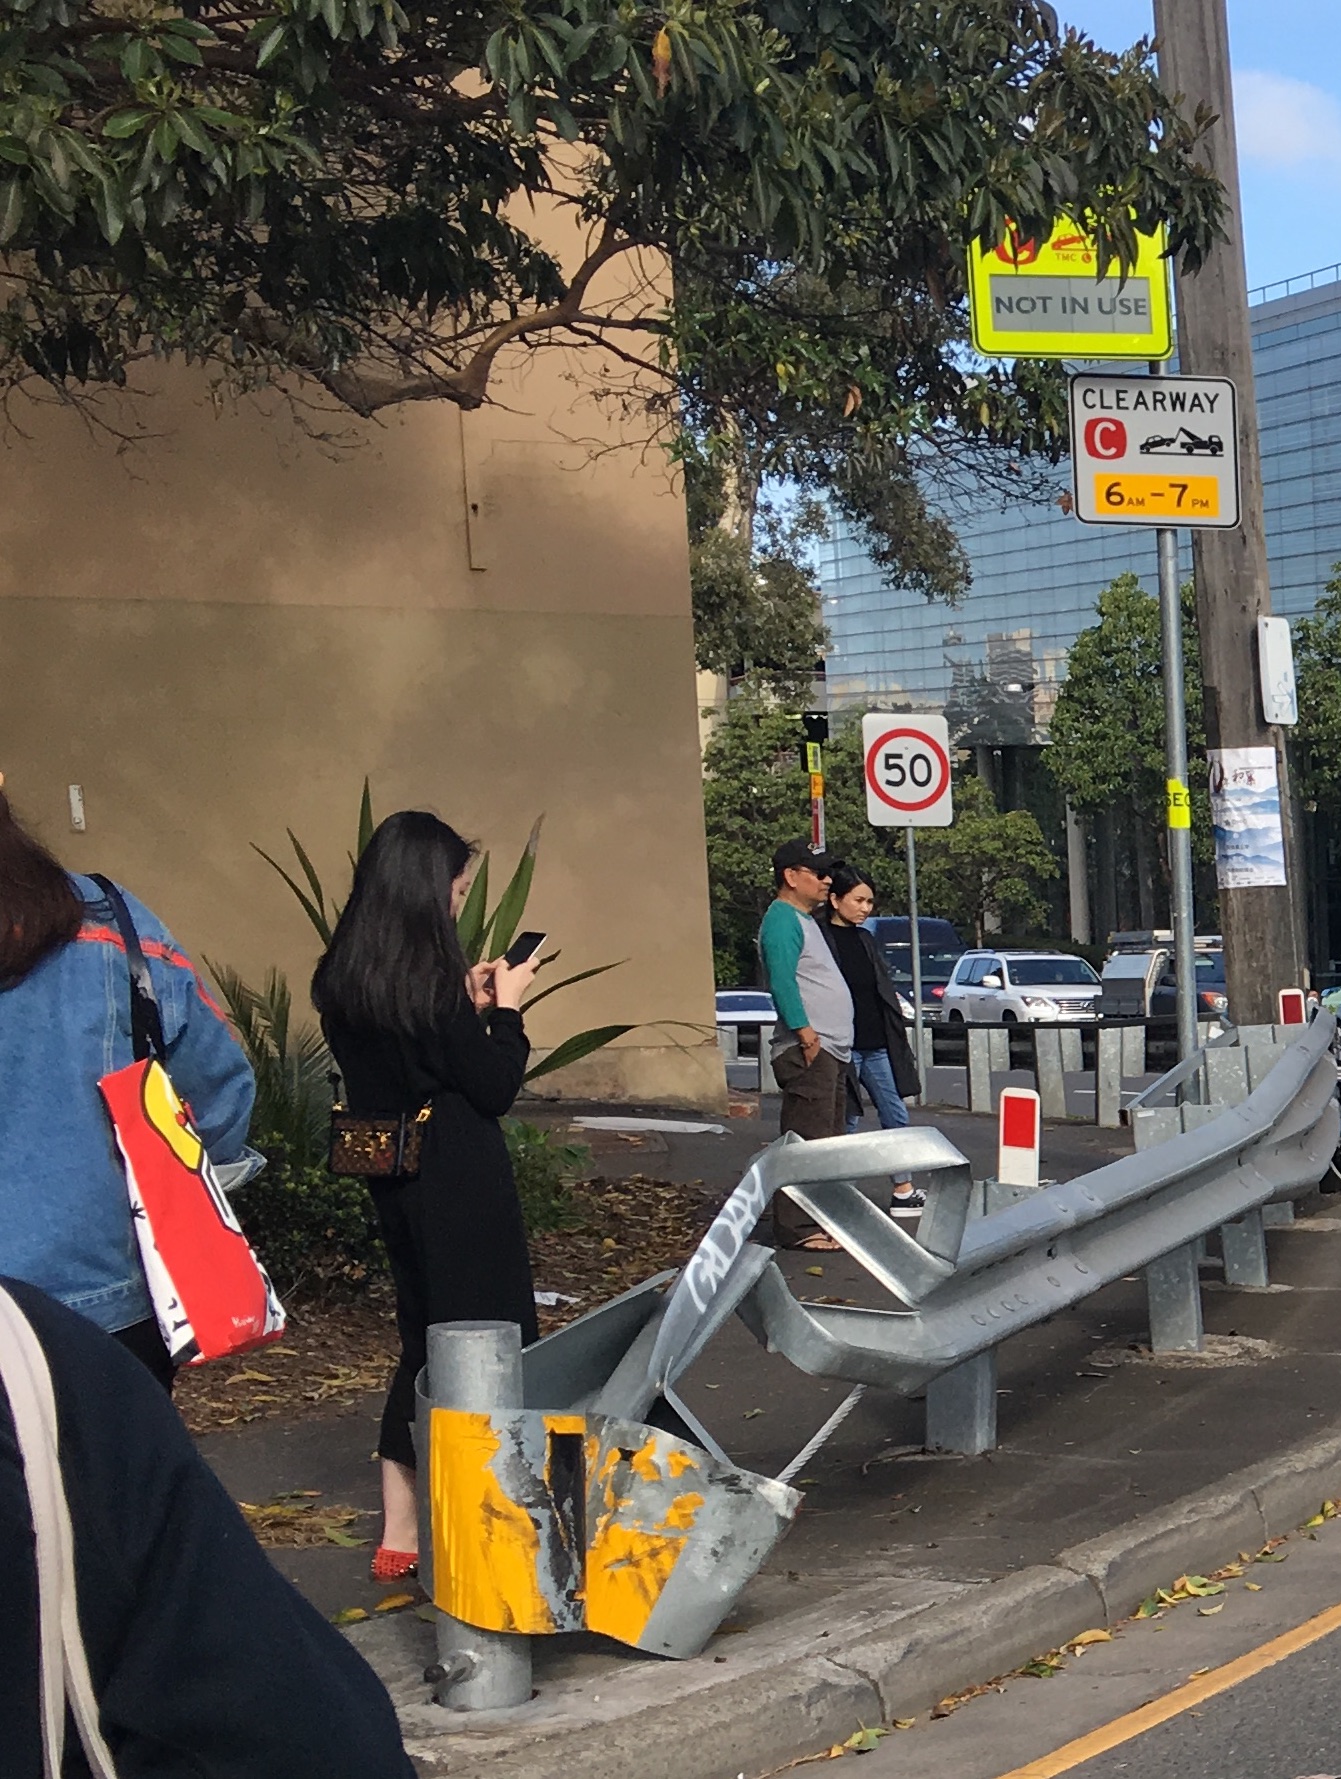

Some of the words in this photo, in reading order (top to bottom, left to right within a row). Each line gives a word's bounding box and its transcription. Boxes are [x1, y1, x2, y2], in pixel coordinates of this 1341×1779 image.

[995, 296, 1053, 315] NOT
[1061, 296, 1089, 315] IN
[1097, 296, 1148, 316] USE
[1082, 387, 1220, 414] CLEARWAY
[1094, 421, 1118, 456] C
[884, 753, 932, 787] 50
